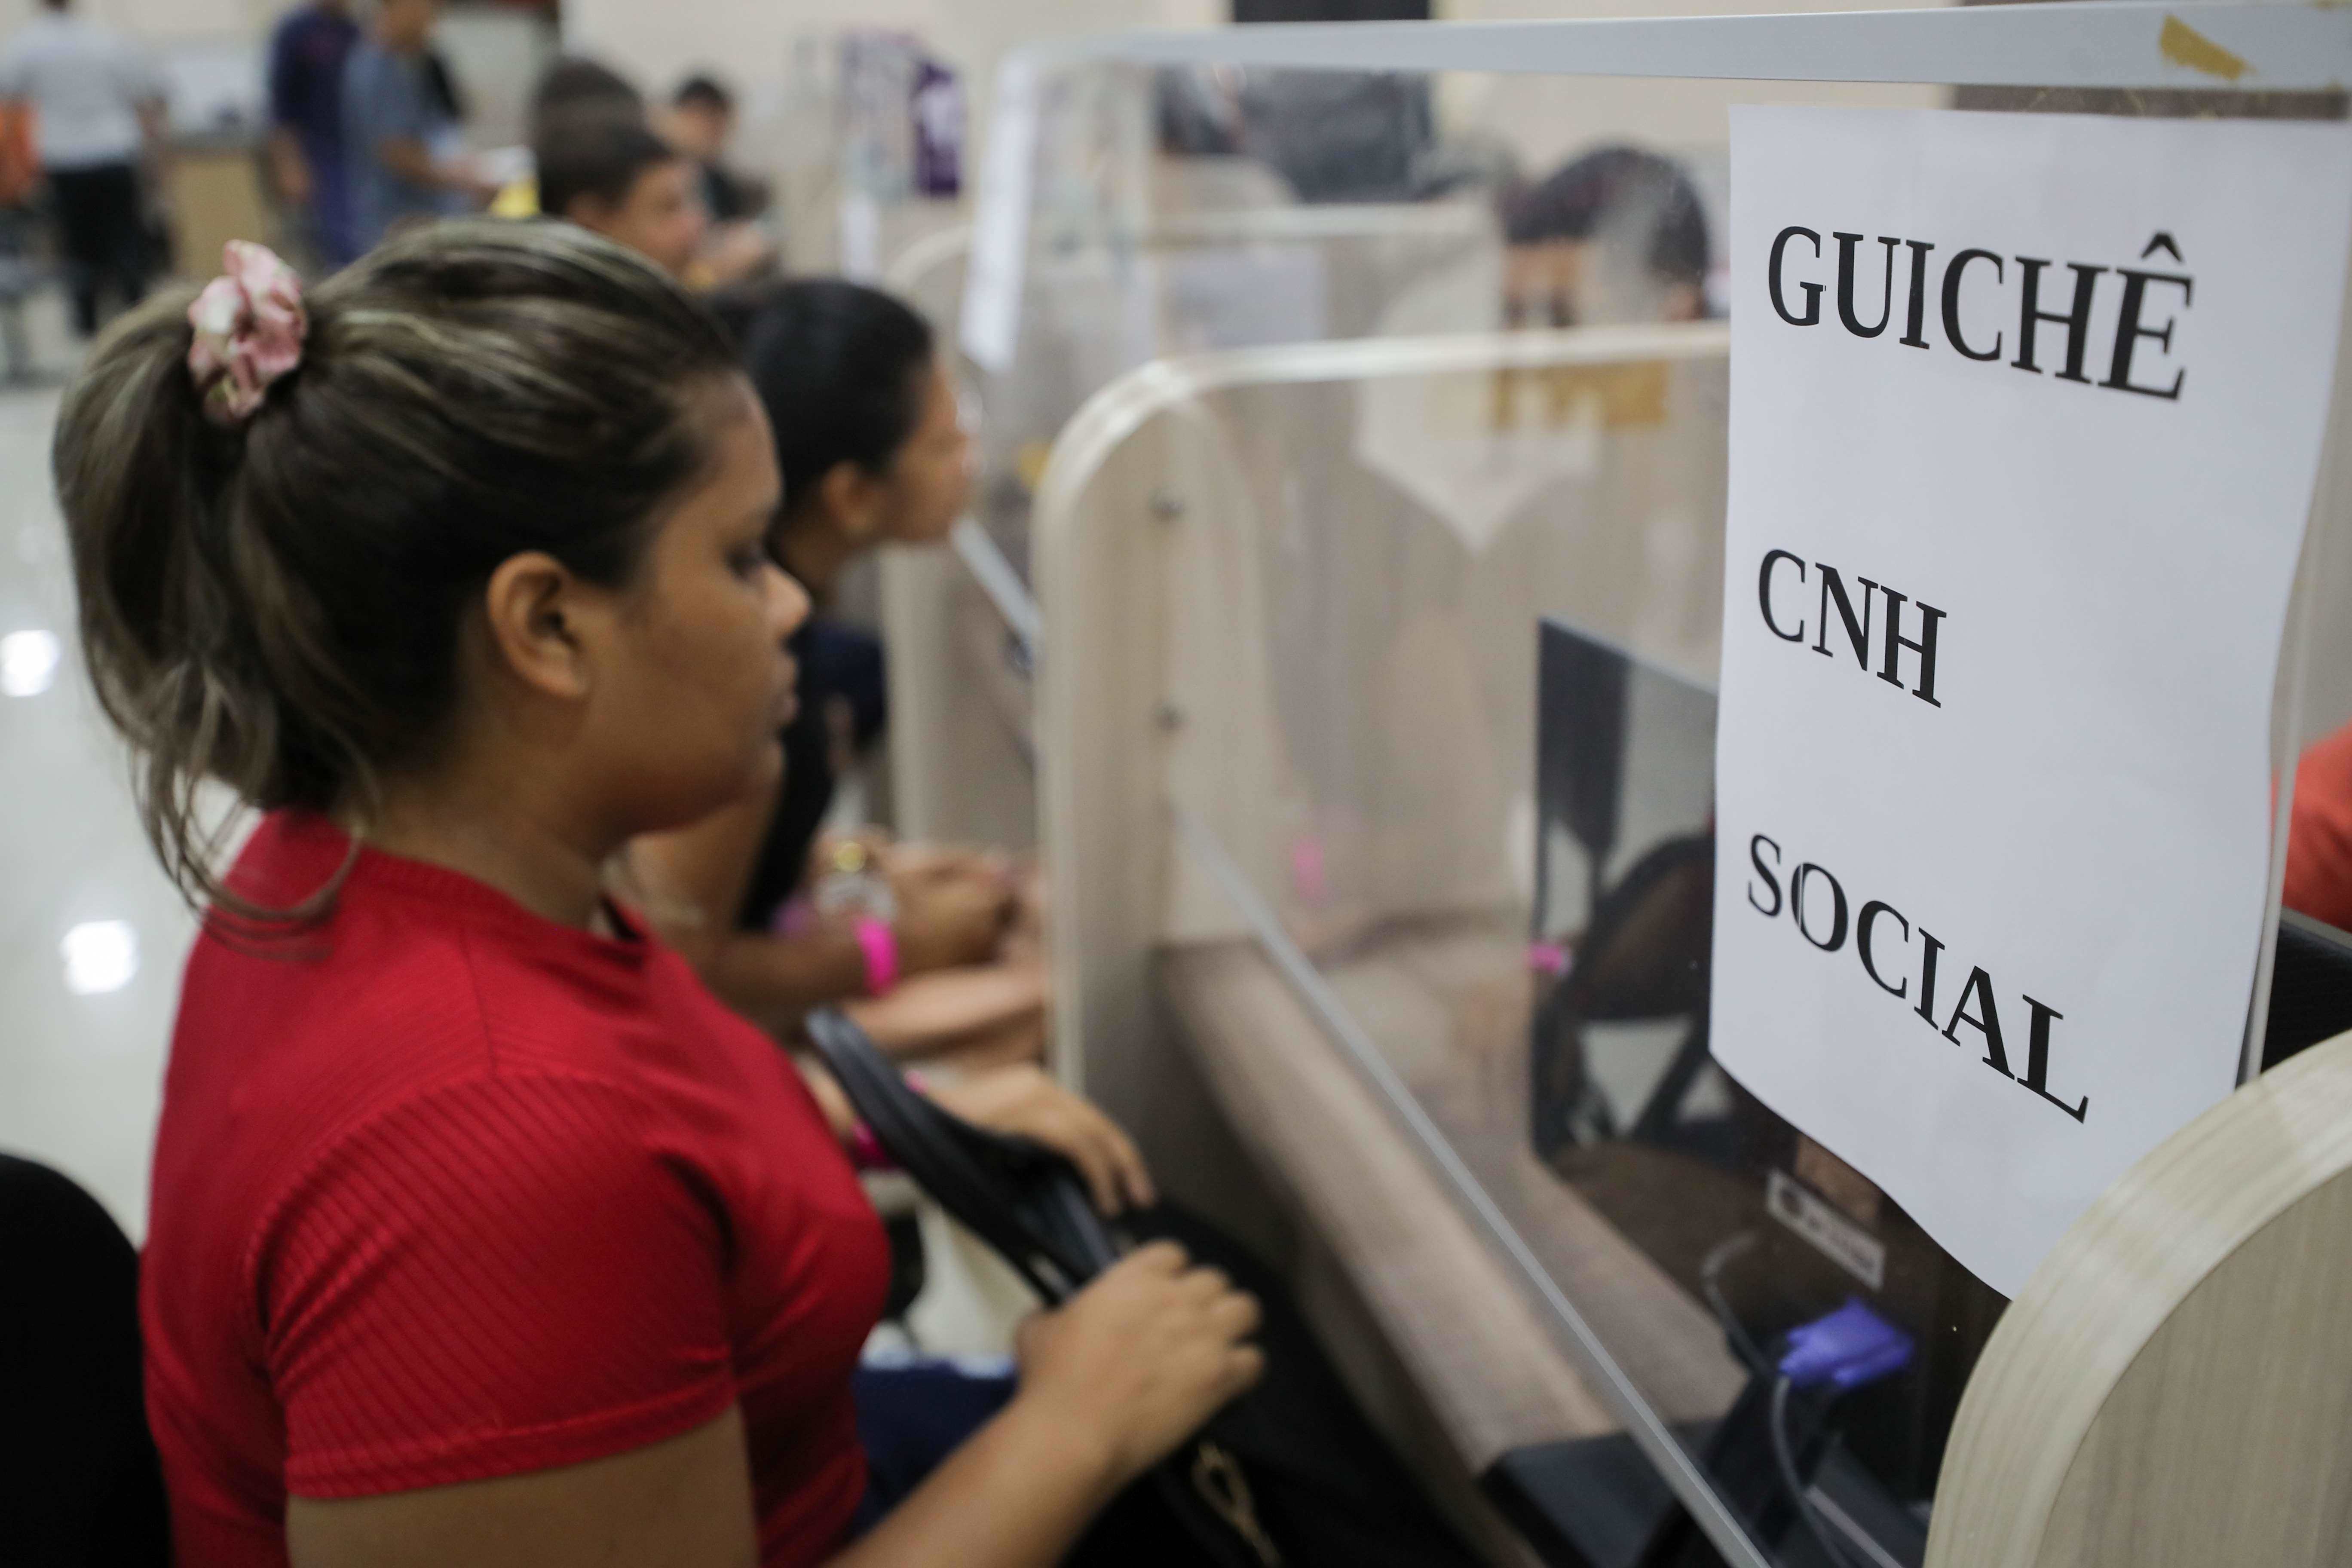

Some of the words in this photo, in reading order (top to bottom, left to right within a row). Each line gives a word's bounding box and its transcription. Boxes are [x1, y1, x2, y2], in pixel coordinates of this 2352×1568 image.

[1768, 226, 2193, 401] GUICHÊ
[1758, 549, 1947, 708] CNH
[1748, 834, 2089, 1124] SOCIAL
